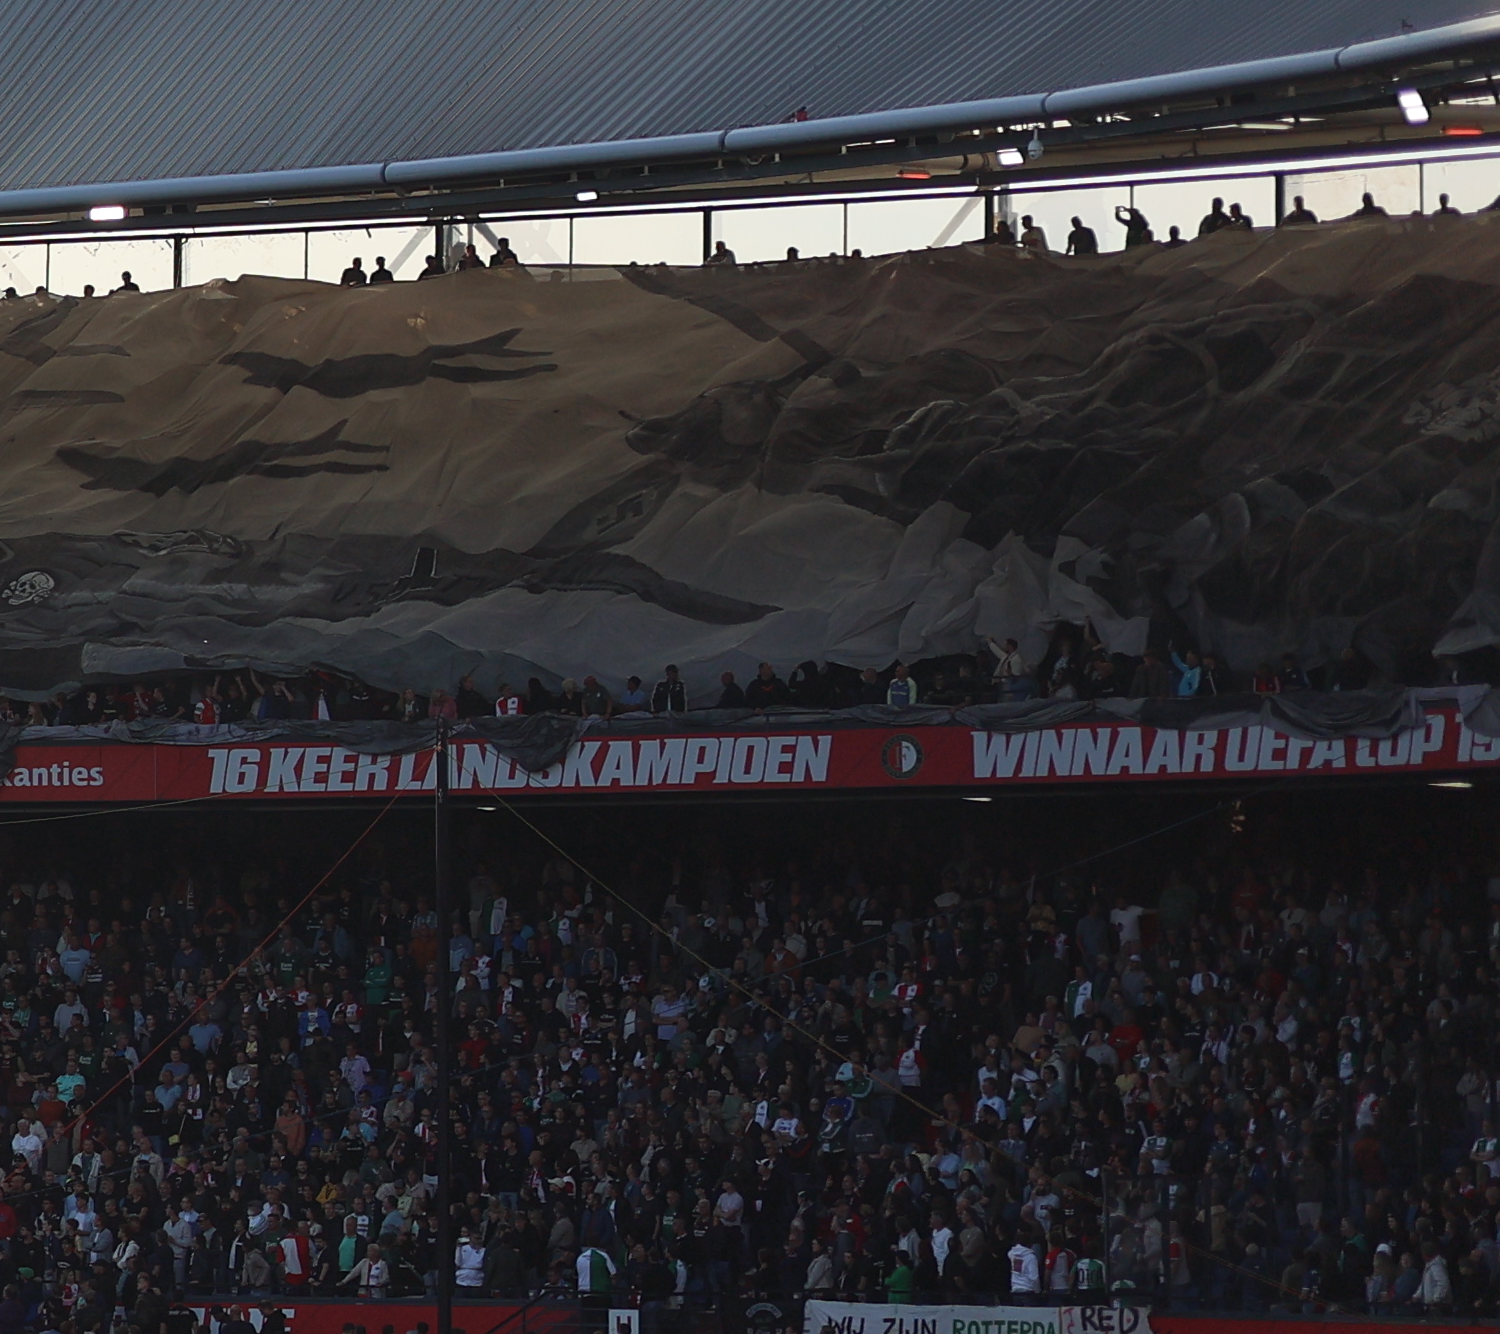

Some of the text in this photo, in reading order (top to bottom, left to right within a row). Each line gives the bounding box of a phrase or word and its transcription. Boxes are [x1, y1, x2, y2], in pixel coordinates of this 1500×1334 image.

[3, 762, 105, 788] anties
[207, 735, 833, 795] 16 KEER LANDSKAMPIOEN
[970, 726, 1219, 778] WINNAAR
[1224, 725, 1347, 772] UEFA
